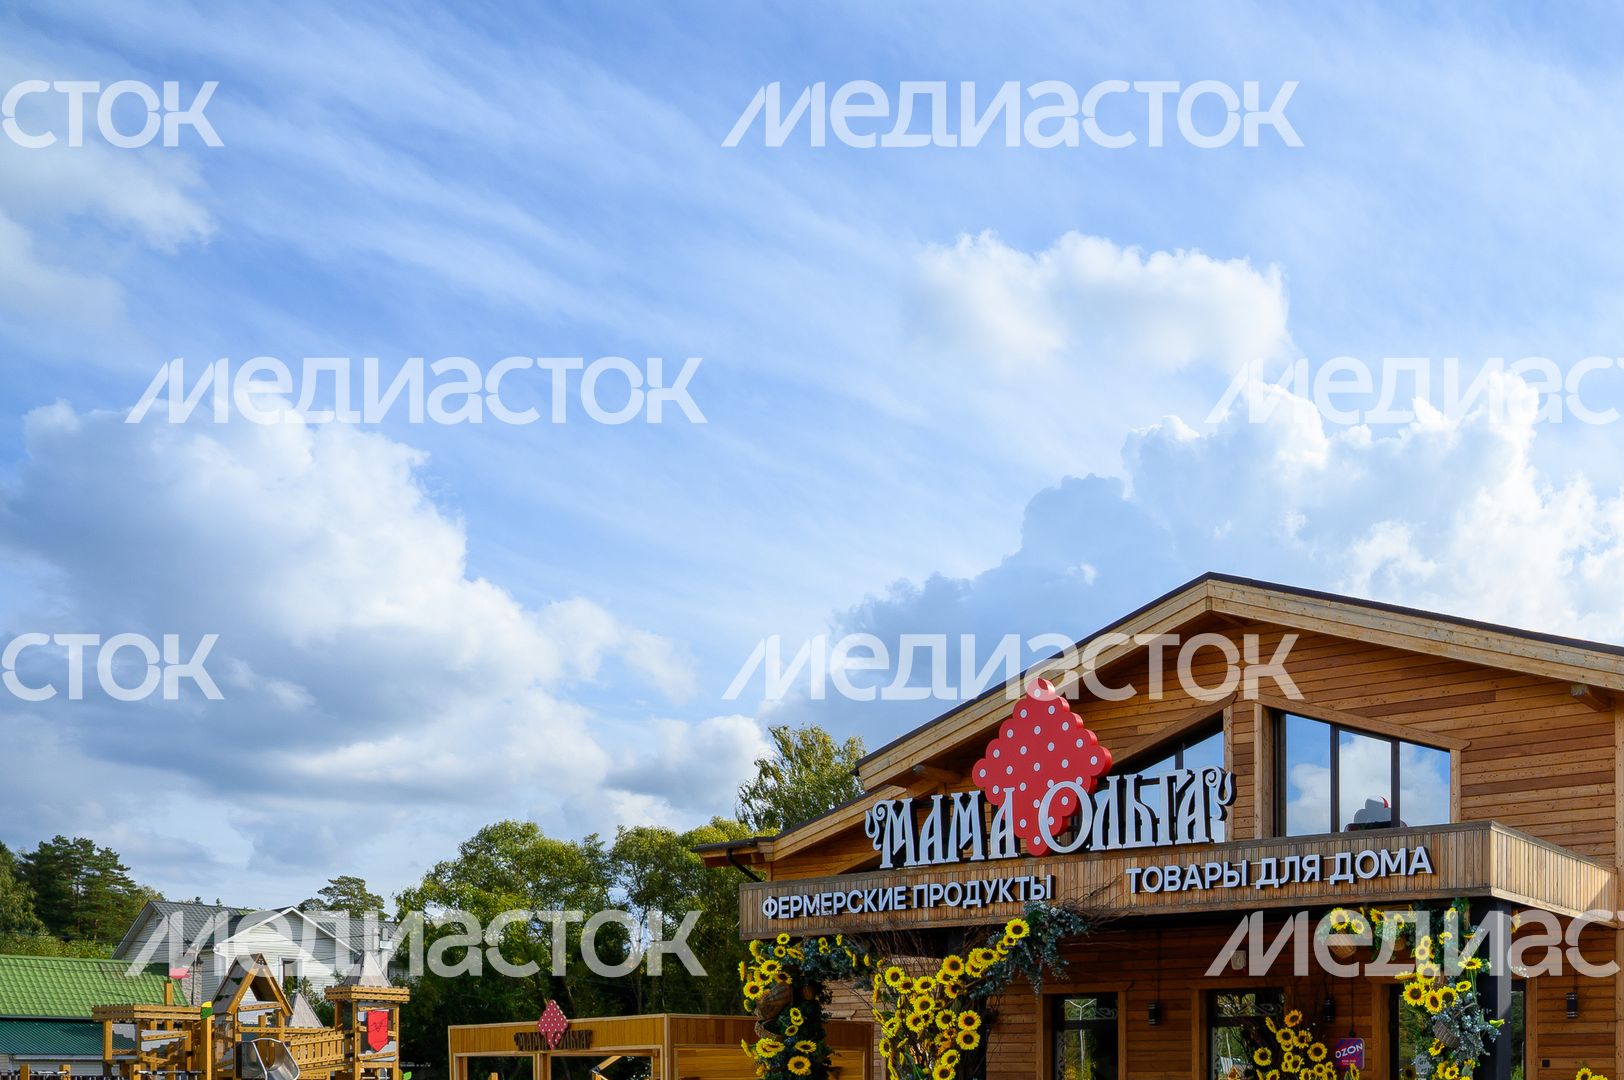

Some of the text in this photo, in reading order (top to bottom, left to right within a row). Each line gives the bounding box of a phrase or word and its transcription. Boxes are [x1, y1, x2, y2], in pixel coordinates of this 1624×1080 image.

[1126, 846, 1433, 893] ТОВАРЫ ДЛЯ ДОМА
[762, 874, 1052, 920] ФЕРМЕРСКИЕ ПРОДУКТЫ
[1335, 1043, 1364, 1059] OZON
